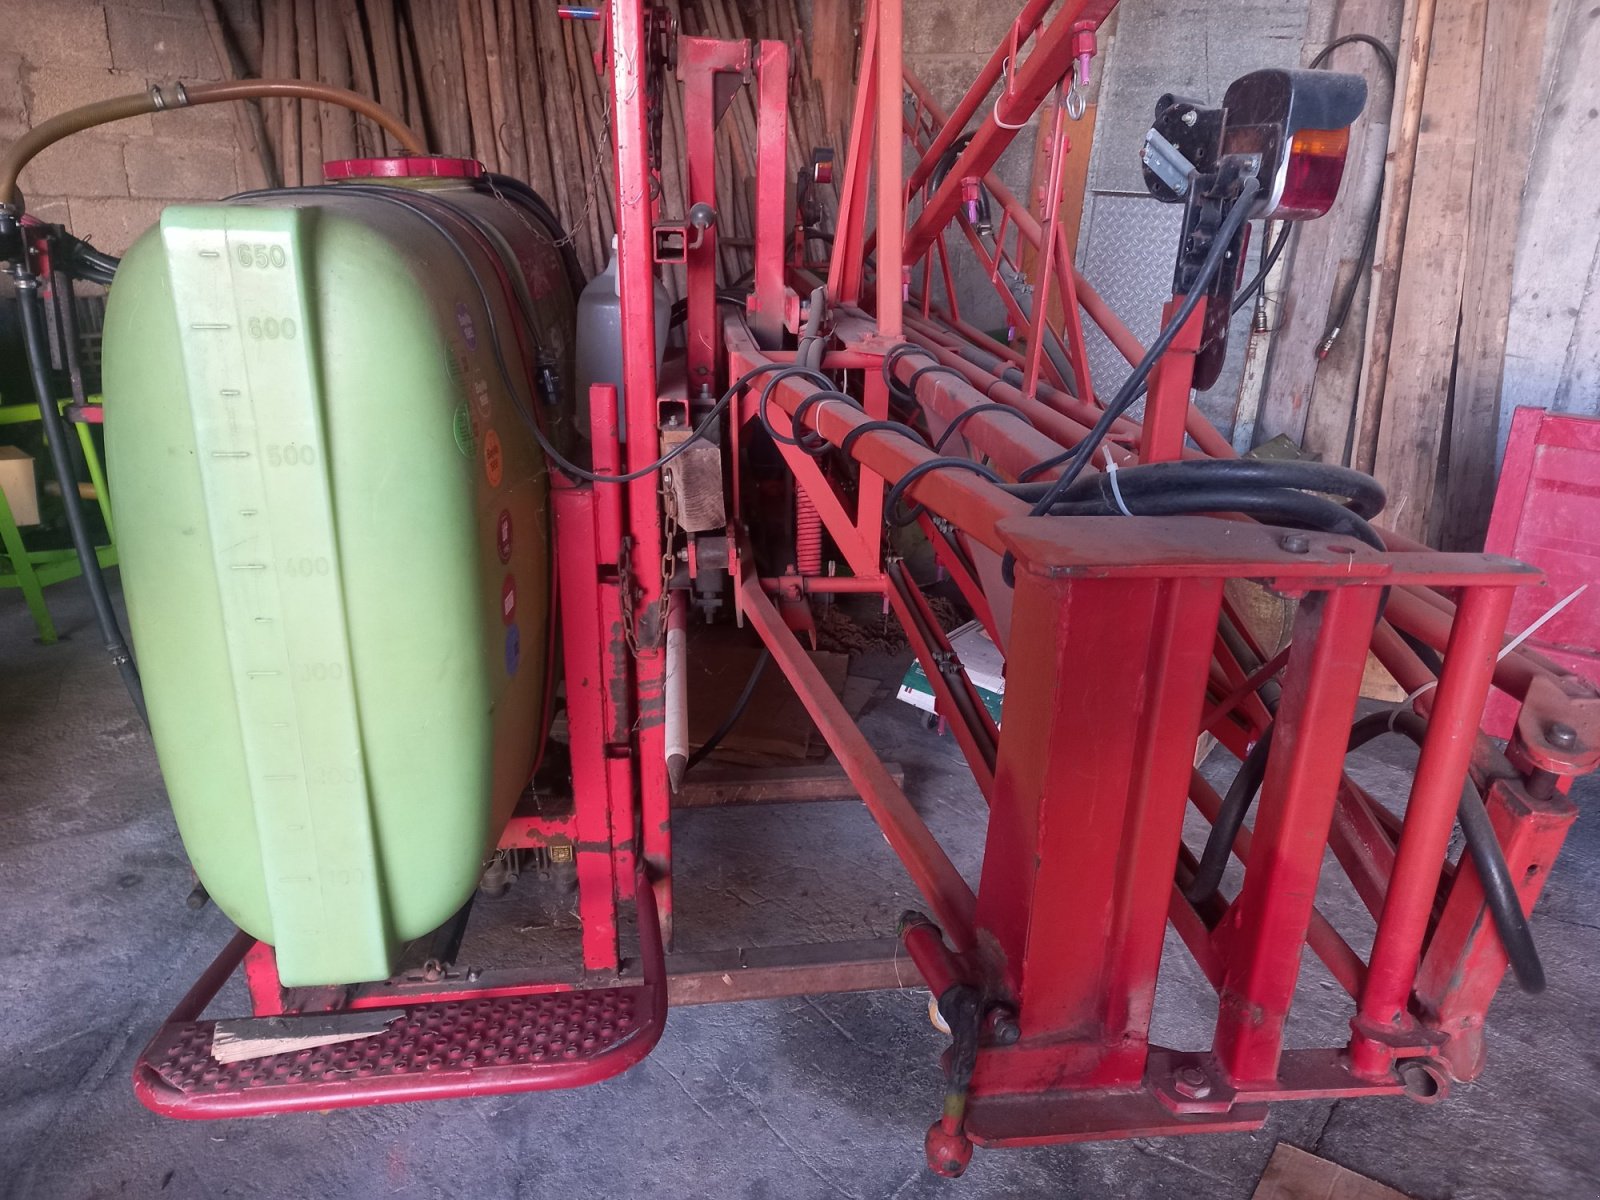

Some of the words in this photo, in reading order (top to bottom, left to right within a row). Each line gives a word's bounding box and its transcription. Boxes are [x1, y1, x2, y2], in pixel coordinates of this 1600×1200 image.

[237, 244, 286, 269] 650
[247, 316, 297, 340] 600
[266, 444, 315, 467] 500
